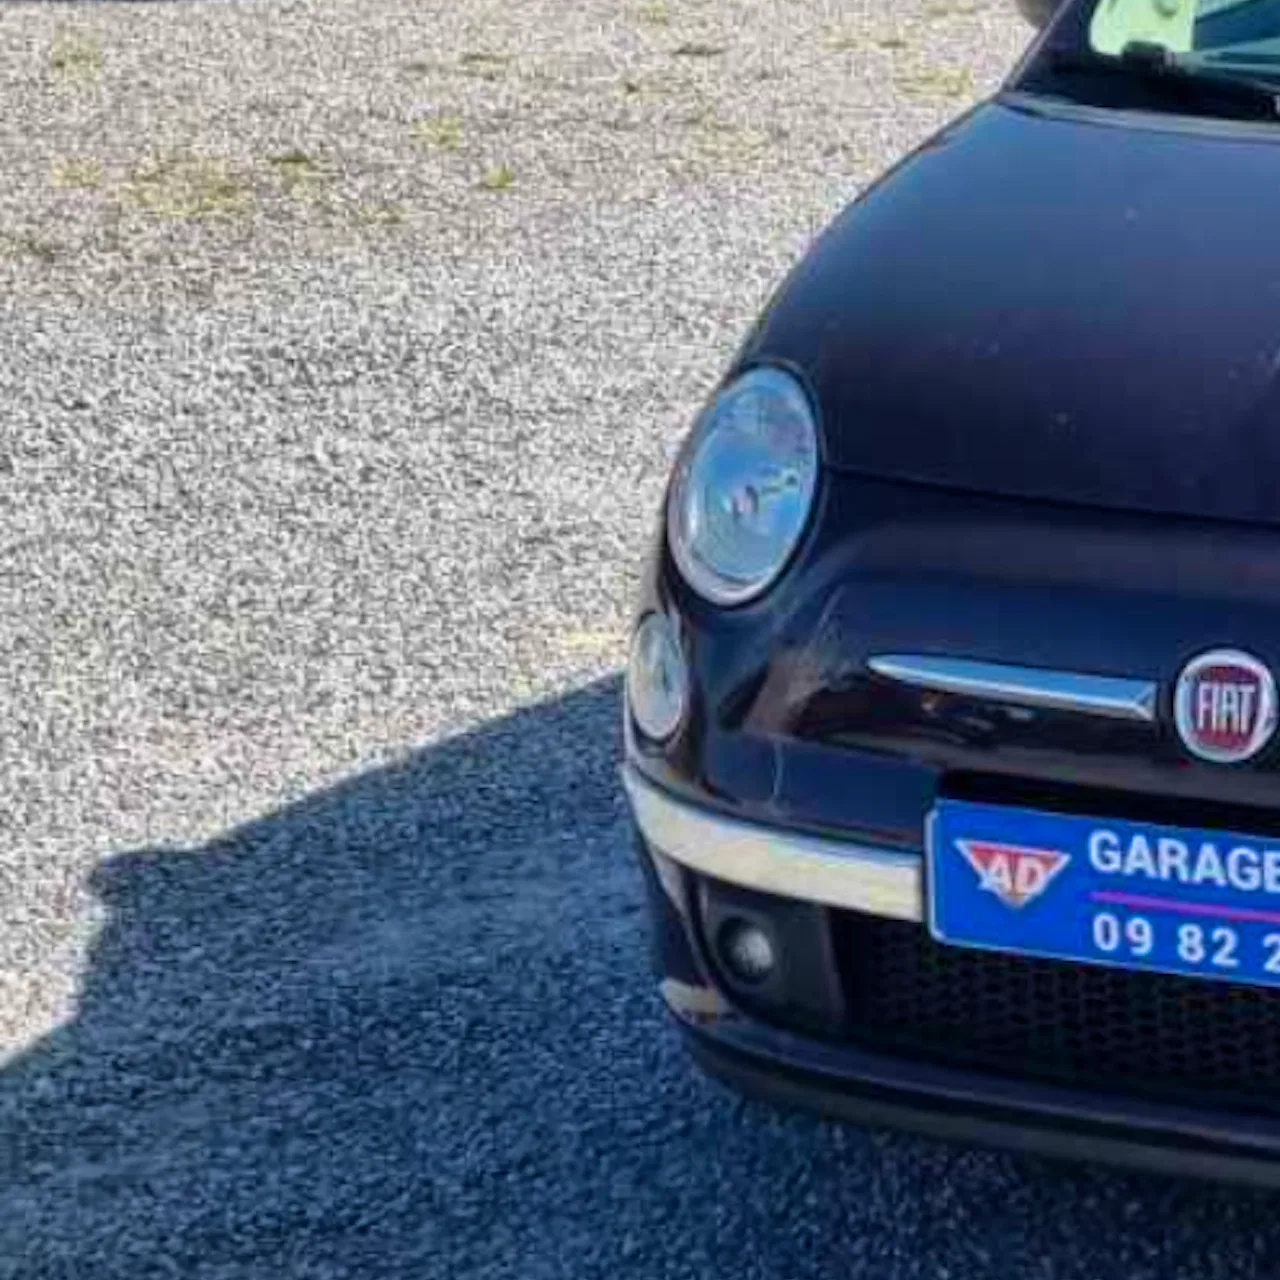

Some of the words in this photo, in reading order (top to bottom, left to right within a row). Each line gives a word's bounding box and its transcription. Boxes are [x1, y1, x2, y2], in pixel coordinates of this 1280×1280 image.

[1198, 680, 1255, 735] FIAT
[977, 851, 1048, 896] AD
[1093, 912, 1153, 956] 09
[1177, 923, 1240, 967] 82
